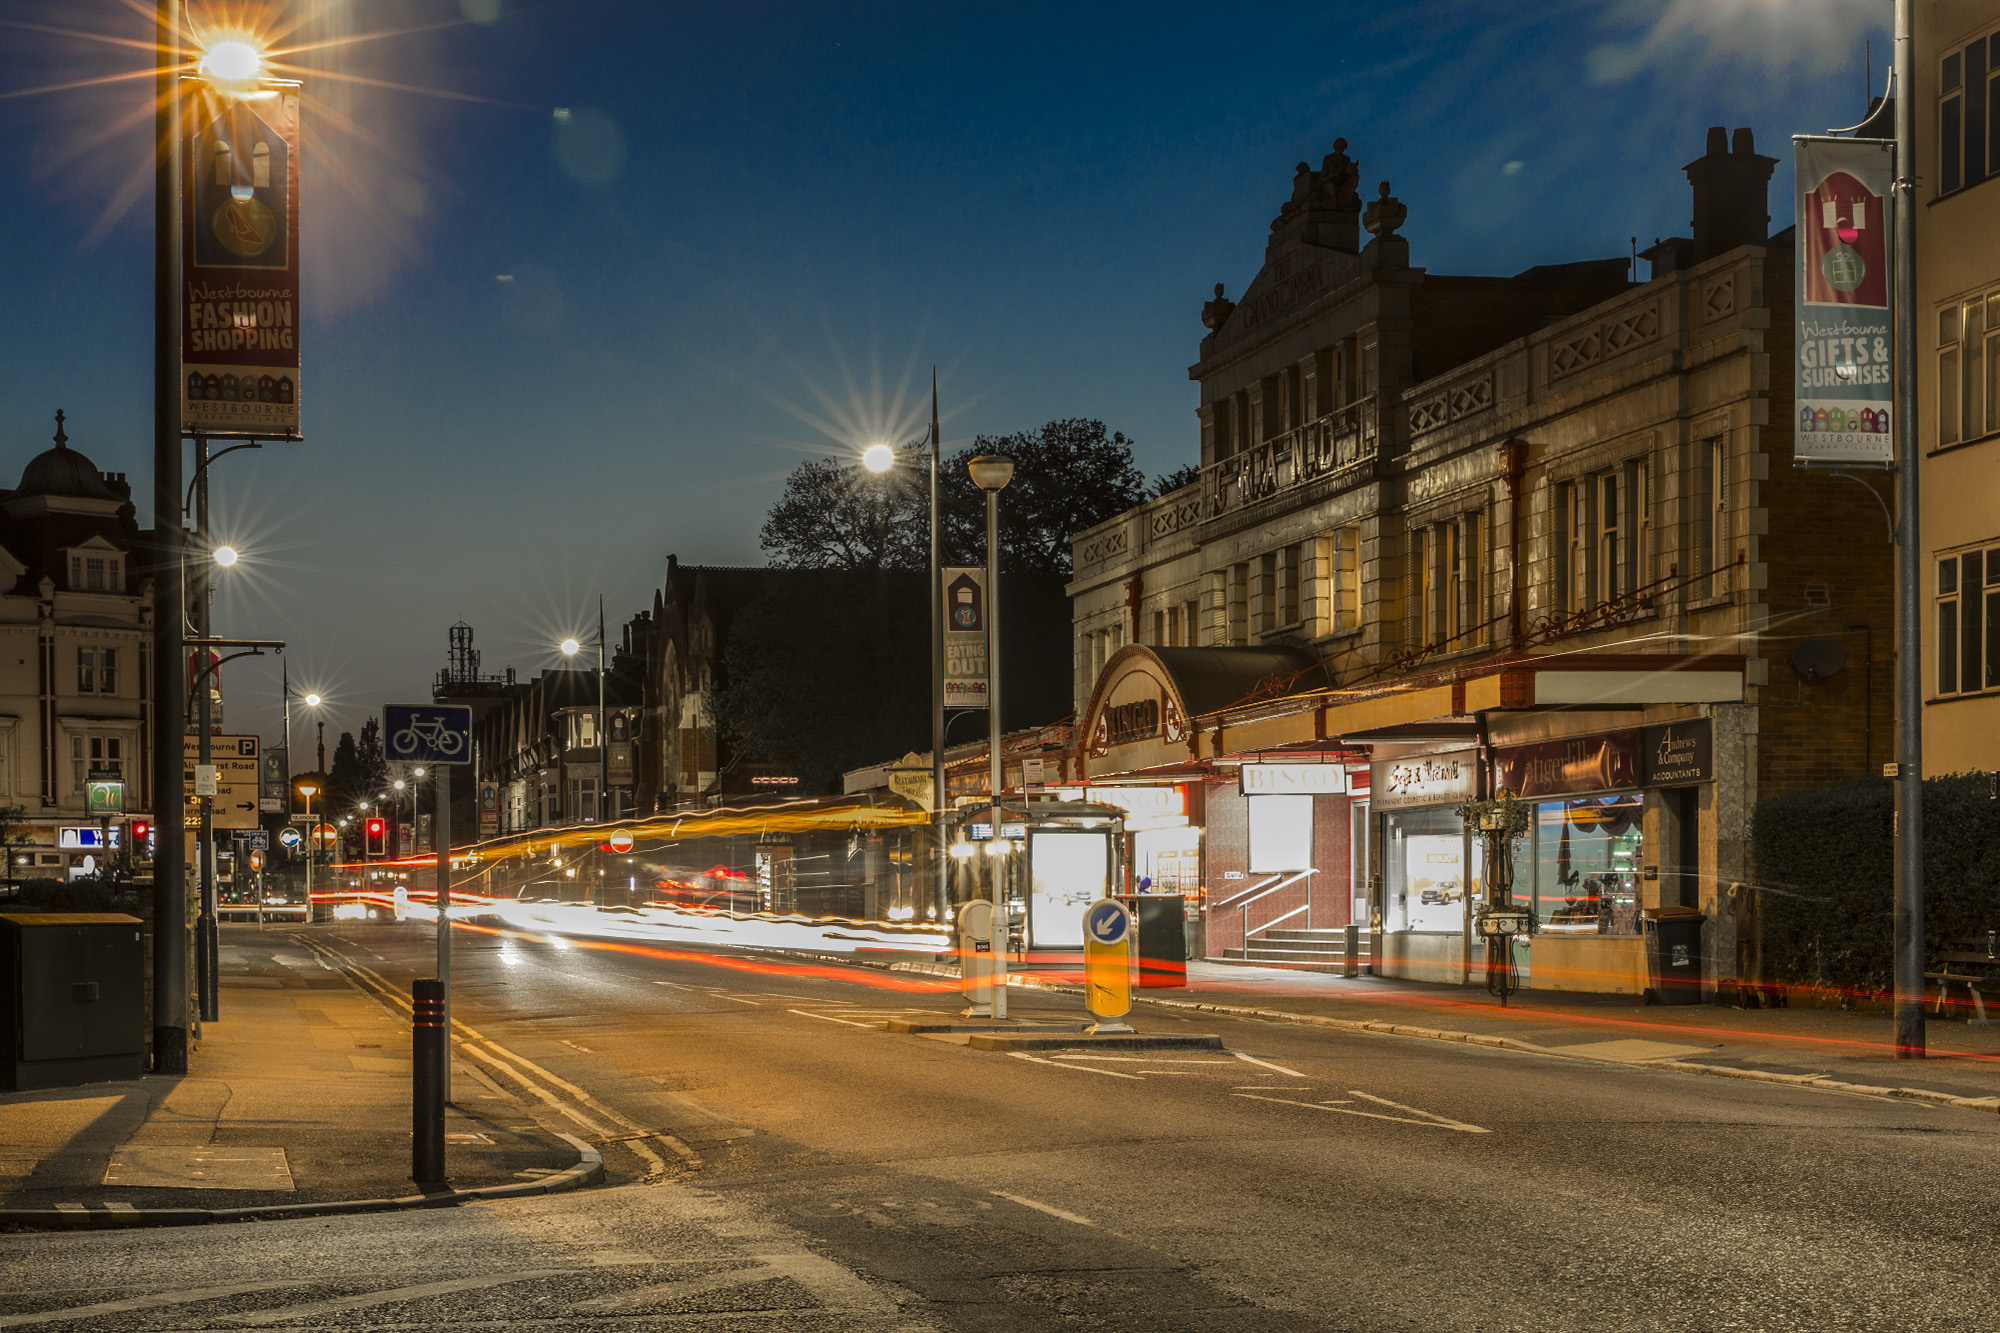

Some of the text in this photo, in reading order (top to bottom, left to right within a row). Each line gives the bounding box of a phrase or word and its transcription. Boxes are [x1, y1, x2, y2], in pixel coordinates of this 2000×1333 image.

[1273, 257, 1292, 284] THE
[188, 281, 294, 301] Westbourne
[1244, 264, 1323, 329] GRAND CINEMA
[190, 301, 293, 329] FASHION
[1801, 320, 1888, 339] Westbourne
[191, 328, 294, 351] SHOPPING
[1801, 337, 1889, 368] GIFTS &
[1802, 364, 1890, 388] SURPRISES
[188, 402, 294, 415] WESTBOURNE
[240, 415, 285, 423] VILLAGE
[1801, 434, 1890, 443] WESTBOURNE
[1215, 413, 1336, 511] GRAND
[947, 645, 985, 659] EATING
[947, 658, 985, 676] OUT
[1107, 699, 1154, 743] BINGO
[184, 742, 236, 751] Wesourne
[1657, 727, 1697, 753] Andrews
[232, 762, 254, 770] Road
[1652, 768, 1701, 781] ACCOUNTANTS
[1248, 768, 1339, 789] BINGO
[1091, 790, 1170, 808] BINGO
[1377, 797, 1402, 806] PERMANENT
[1404, 795, 1426, 804] COSMETIC
[1433, 792, 1450, 801] BEAUTY
